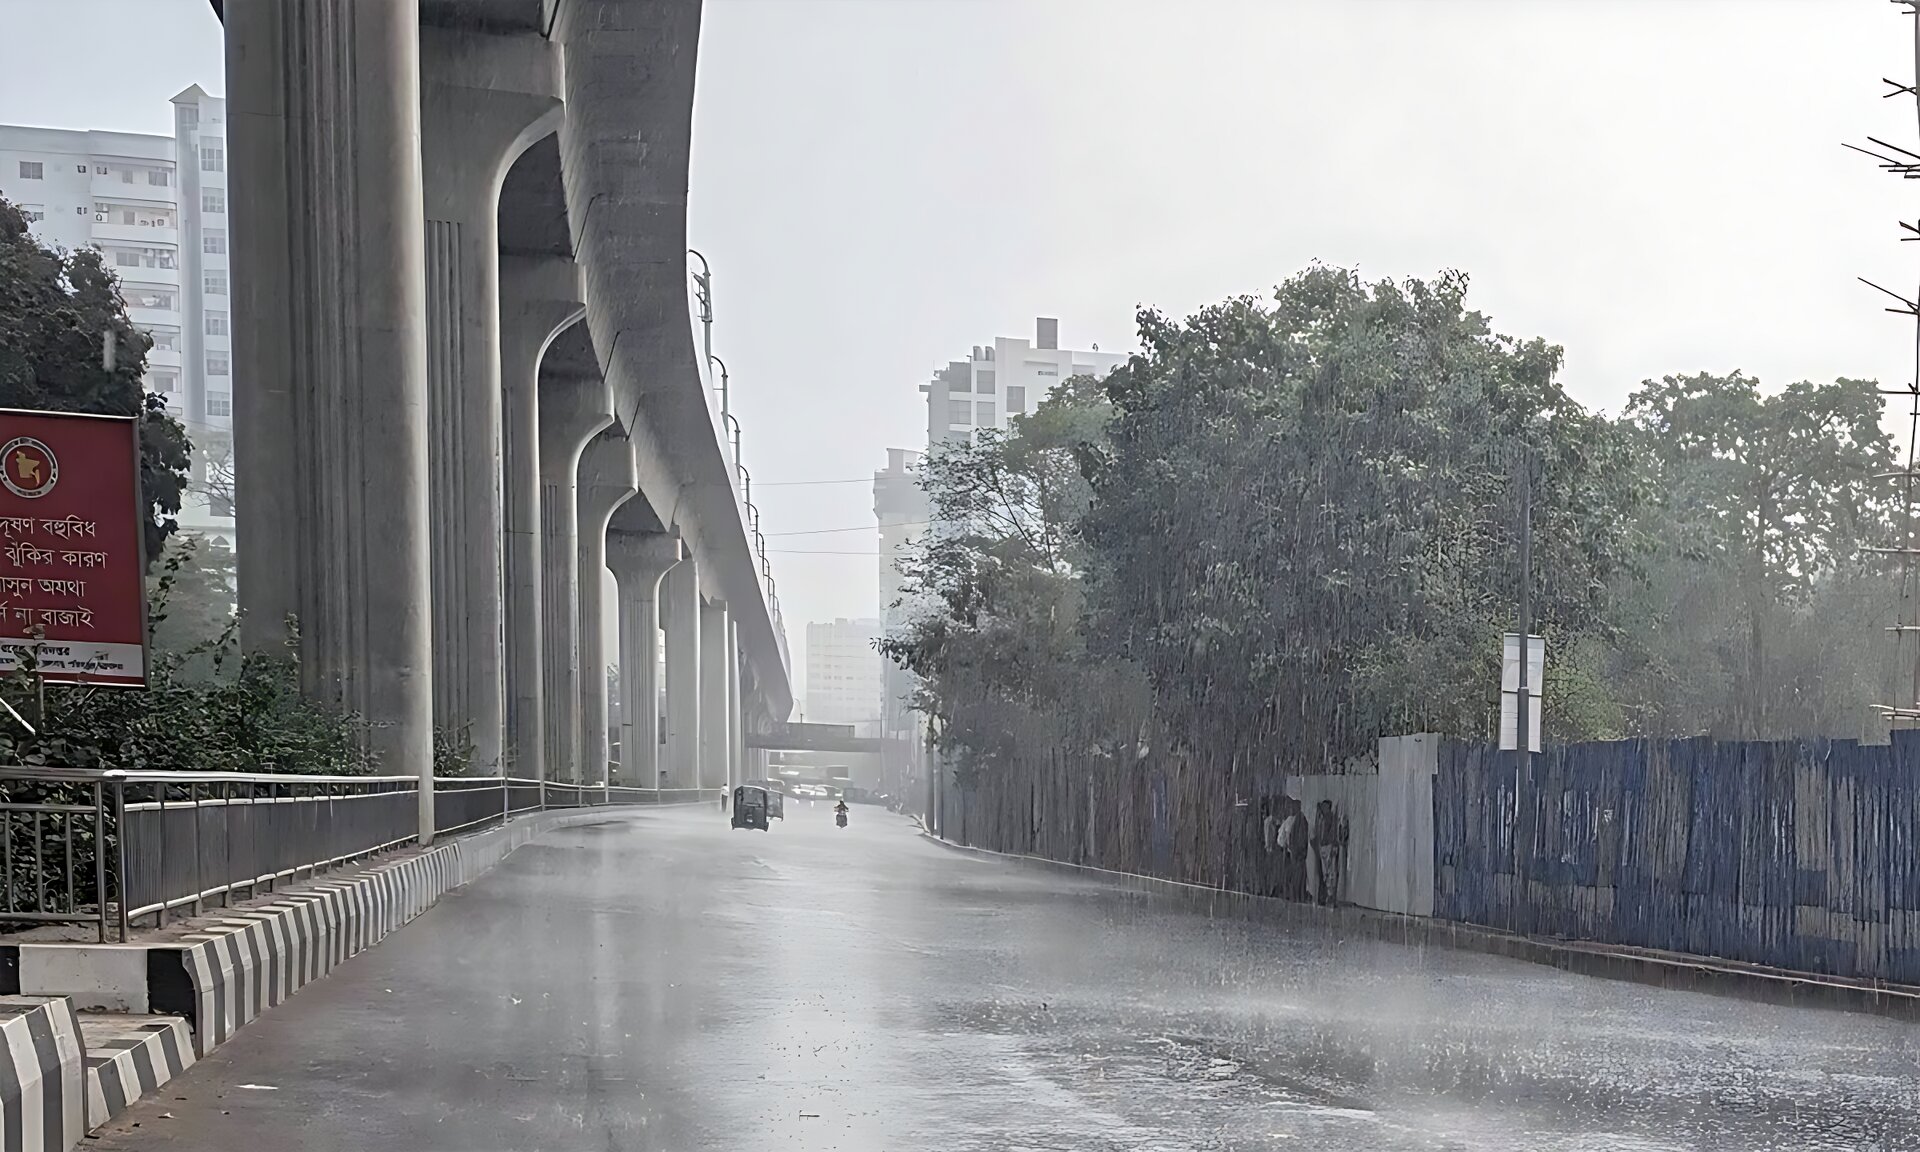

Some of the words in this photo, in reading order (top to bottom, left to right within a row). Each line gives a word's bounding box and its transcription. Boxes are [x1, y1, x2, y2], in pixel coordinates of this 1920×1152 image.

[60, 550, 108, 569] কারণ
[13, 607, 34, 625] না
[38, 605, 95, 629] বাজাই
